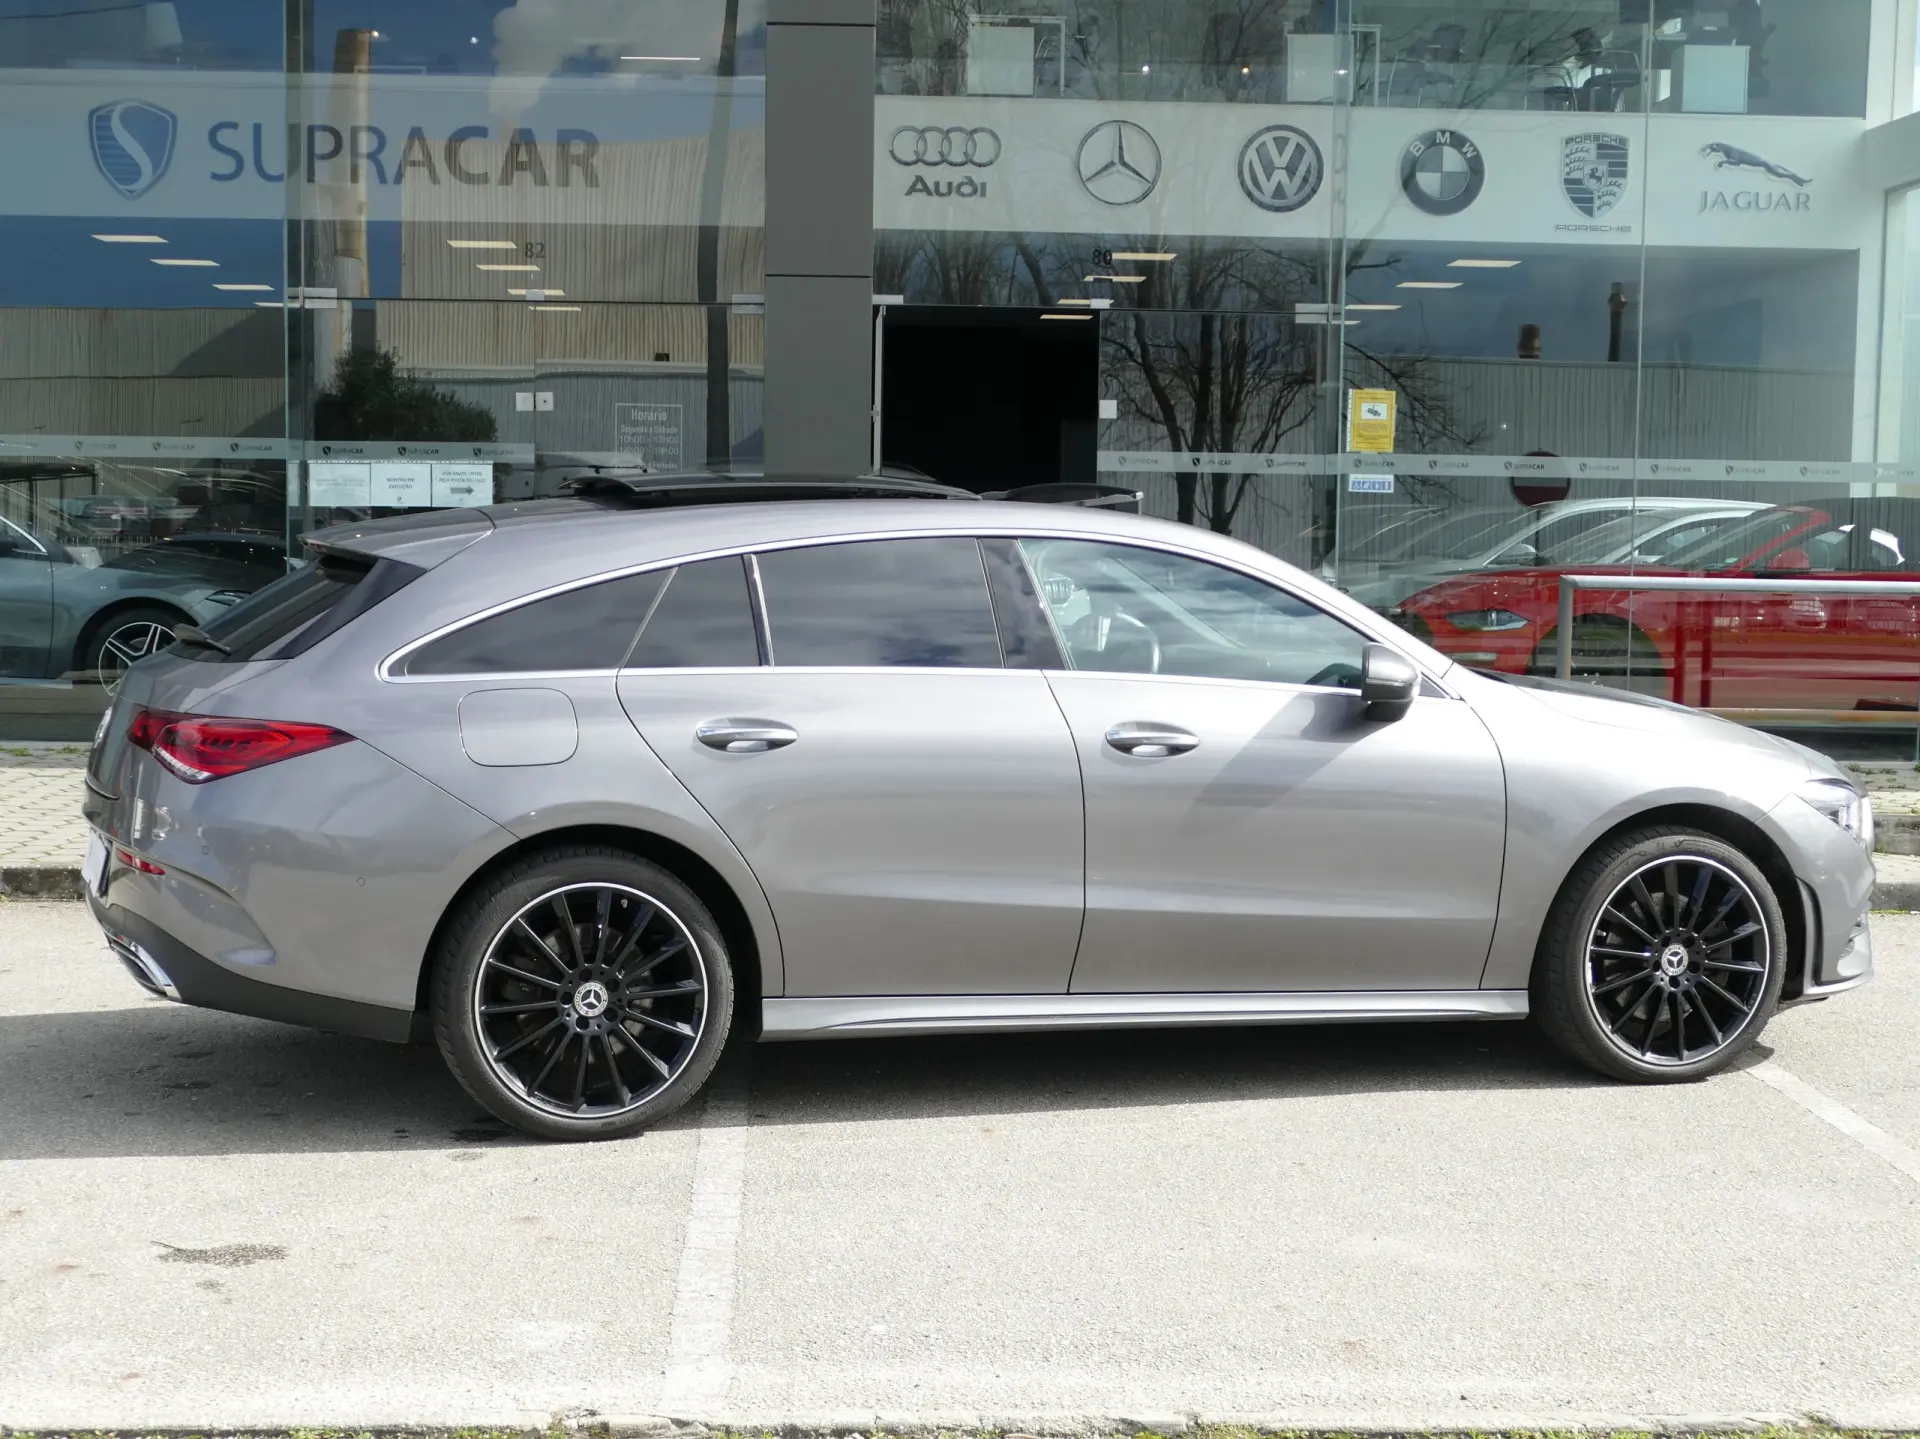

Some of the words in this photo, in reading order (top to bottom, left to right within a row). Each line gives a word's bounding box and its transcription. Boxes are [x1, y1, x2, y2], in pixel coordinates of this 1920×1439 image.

[1409, 131, 1477, 158] BMW
[1565, 133, 1628, 147] PORSCHE
[206, 121, 600, 188] SUPRACAR
[904, 174, 988, 198] Audi
[1700, 190, 1811, 213] JAGUAR
[1555, 224, 1632, 233] PORSCHE
[525, 242, 545, 259] 82
[1092, 248, 1112, 266] 80
